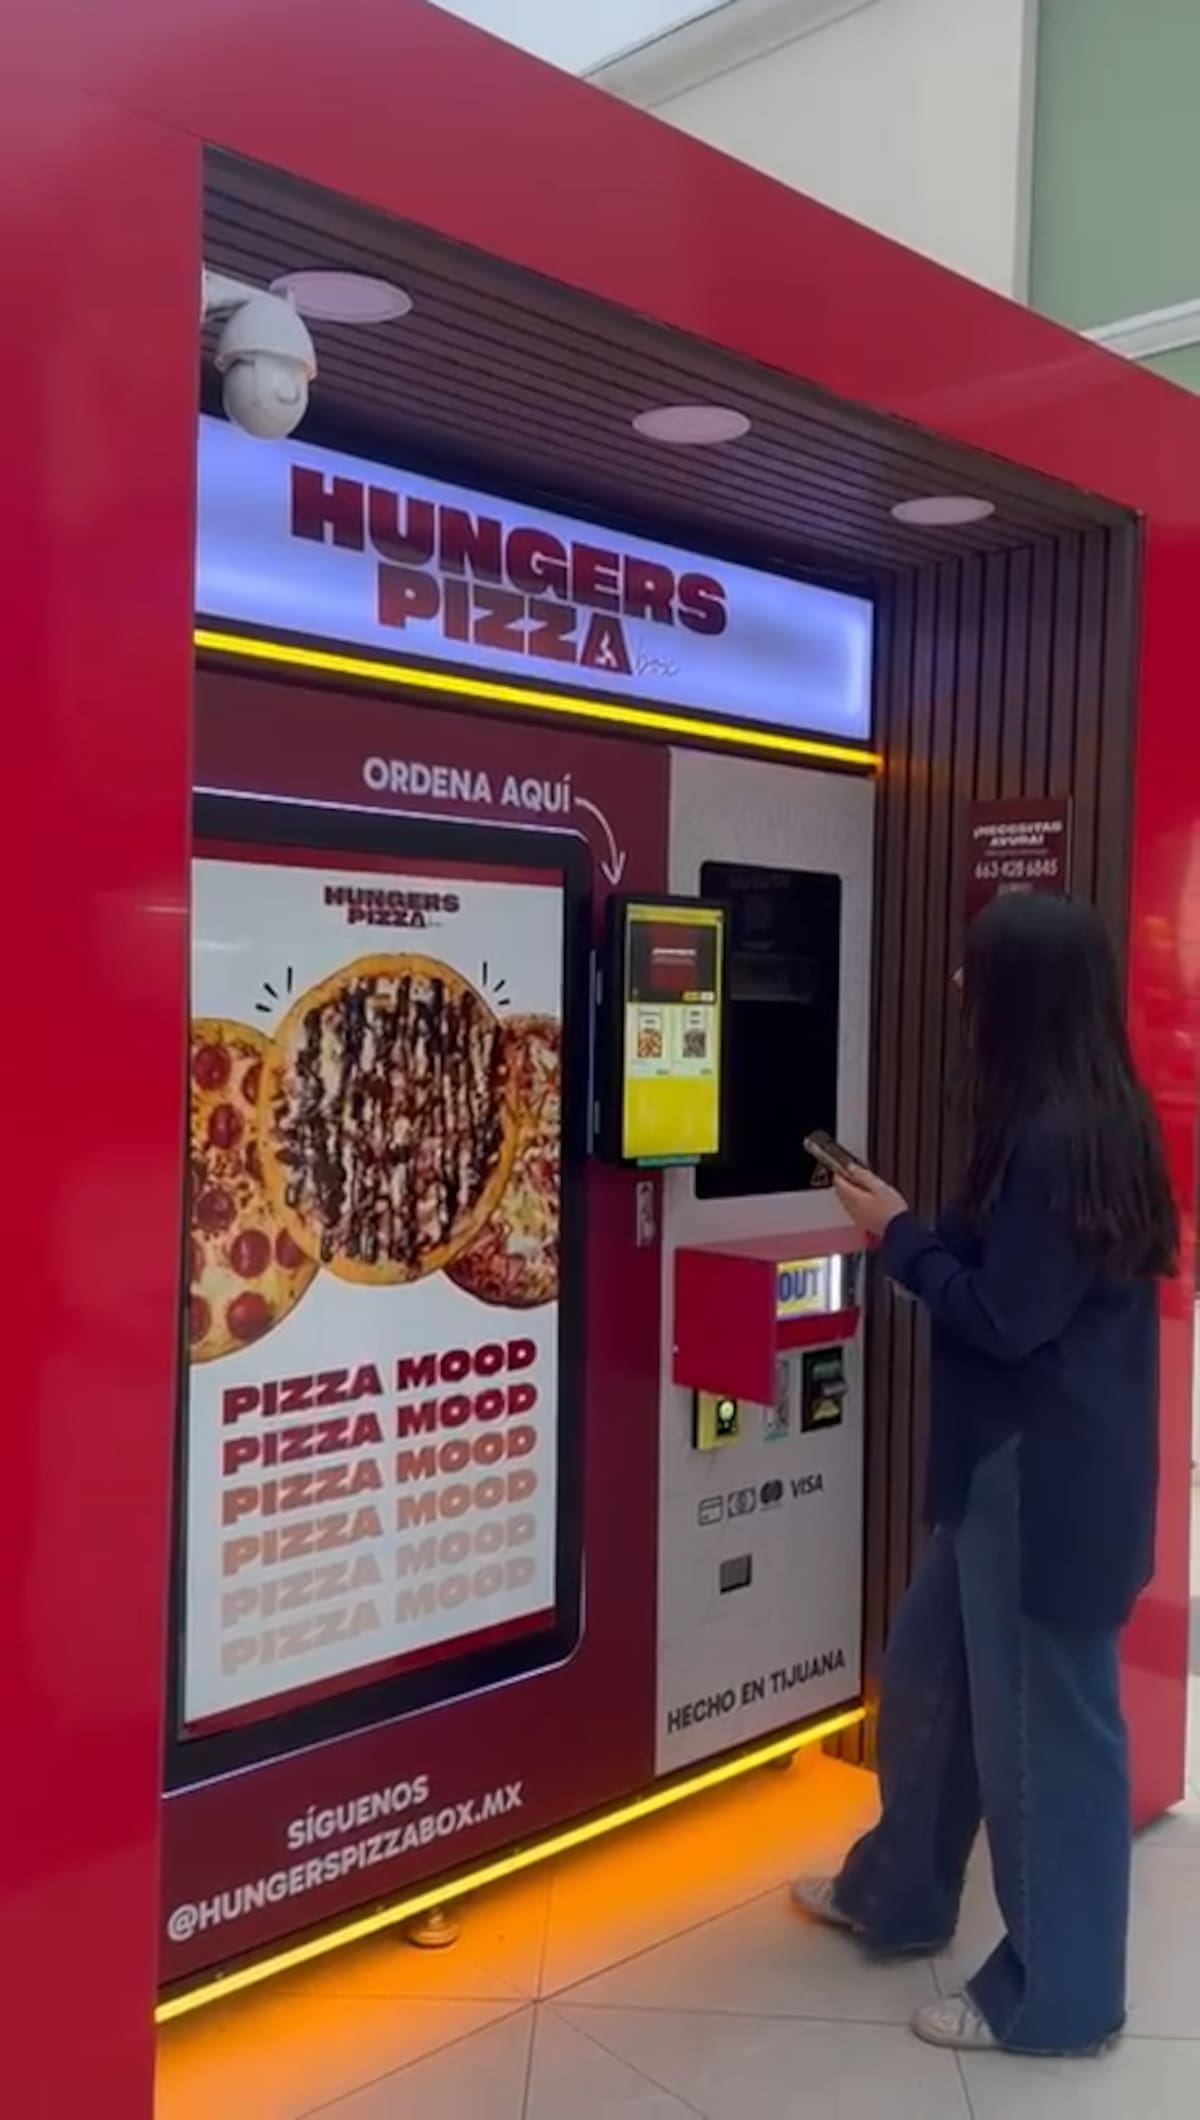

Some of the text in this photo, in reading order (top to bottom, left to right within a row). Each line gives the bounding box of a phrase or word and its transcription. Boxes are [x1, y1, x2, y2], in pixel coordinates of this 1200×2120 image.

[290, 463, 728, 636] HUNGERS
[377, 562, 633, 675] PIZZA
[363, 756, 571, 813] ORDENA AQUÍ
[324, 886, 460, 913] HUNGERS
[347, 906, 427, 928] PIZZA
[779, 1269, 819, 1301] OUT
[222, 1338, 537, 1425] PIZZA MOOD
[222, 1382, 537, 1476] PIZZA MOOD
[222, 1425, 537, 1526] PIZZA MOOD
[790, 1474, 823, 1498] VISA
[222, 1468, 537, 1577] PIZZA MOOD
[221, 1513, 536, 1628] PIZZA MOOD
[221, 1557, 536, 1676] PIZZA MOOD
[667, 1648, 845, 1733] HECHO EN TIJUANA
[287, 1775, 430, 1849] SÍGUENOS
[167, 1781, 523, 1941] @HUNGERSPIZZABOX.MX
